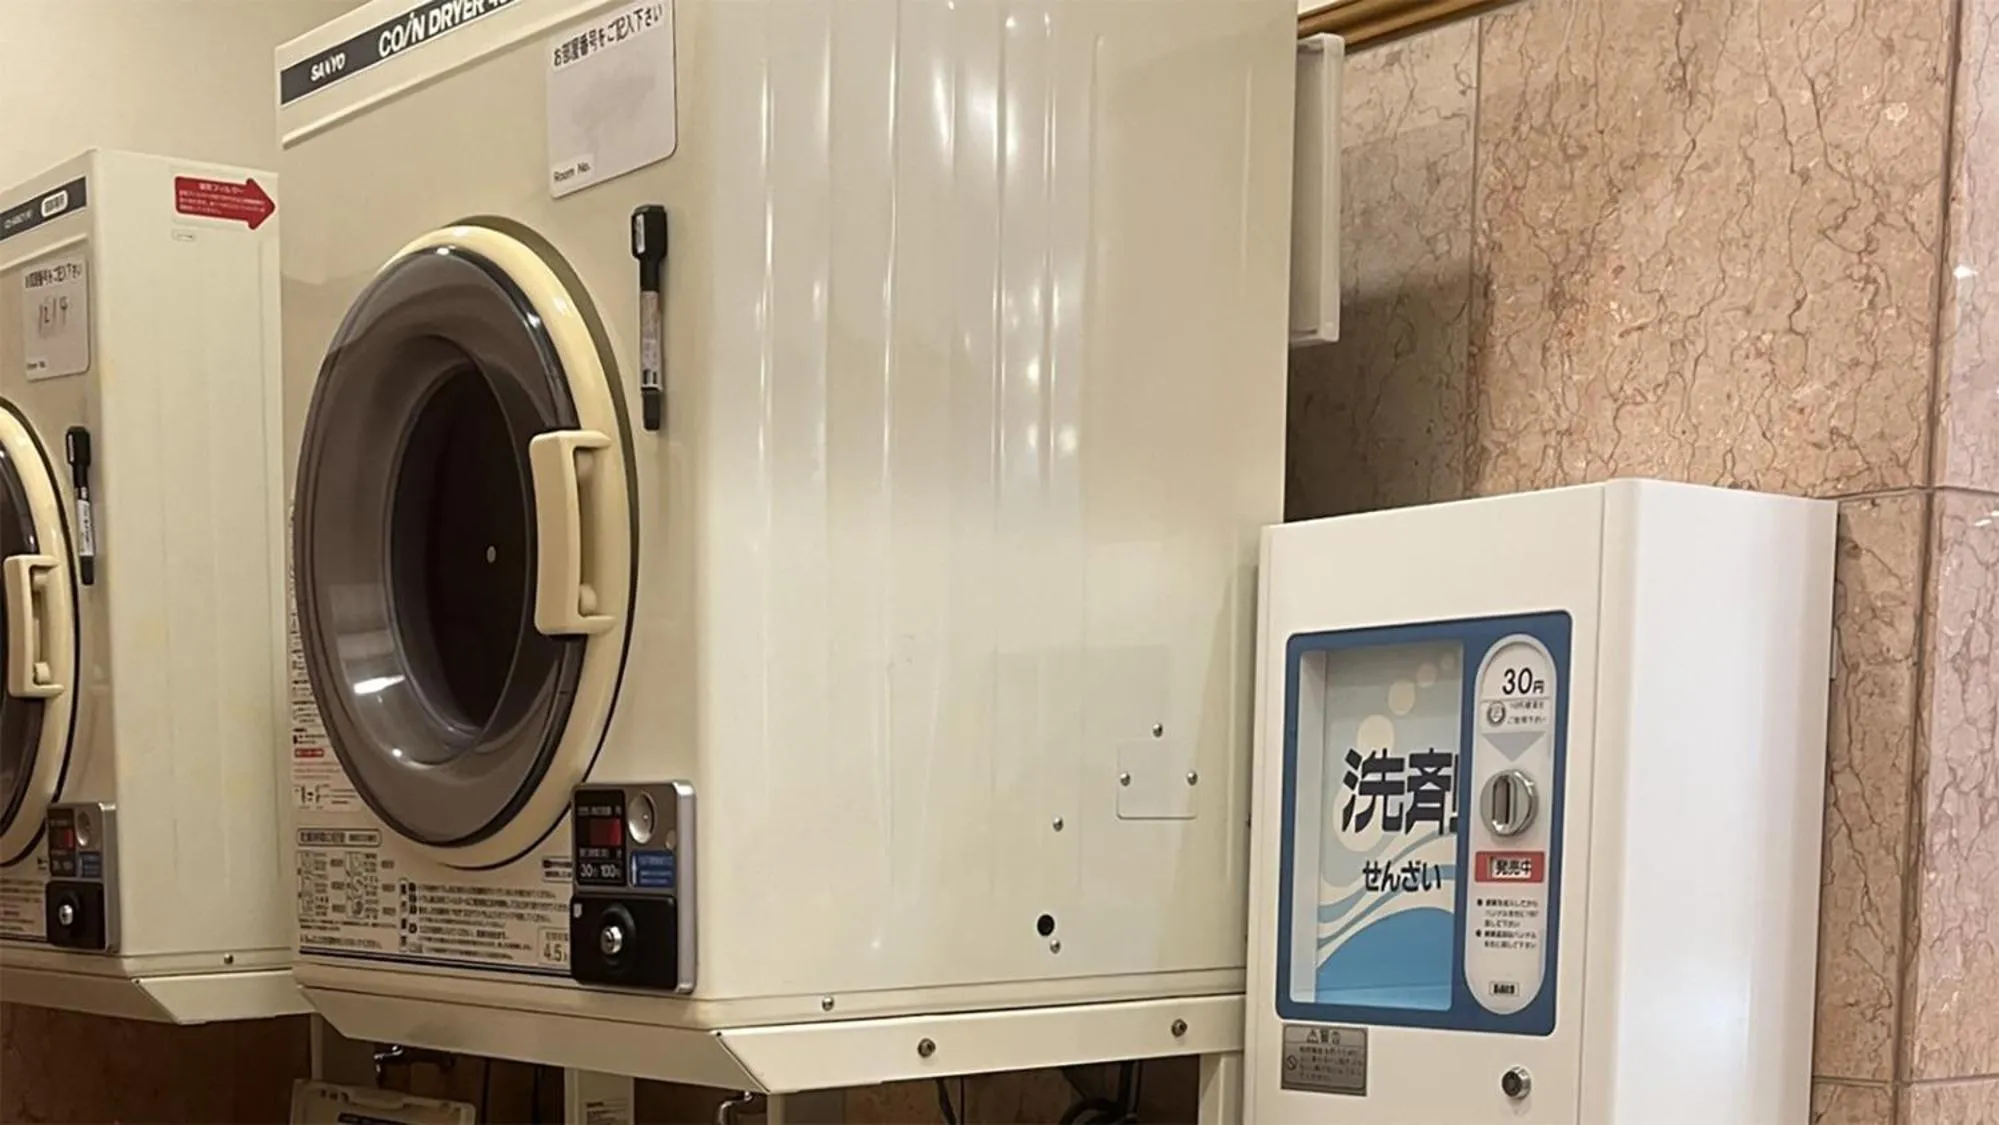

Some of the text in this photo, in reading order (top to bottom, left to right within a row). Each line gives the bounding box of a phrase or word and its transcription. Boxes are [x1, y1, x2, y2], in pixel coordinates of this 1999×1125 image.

[310, 53, 346, 82] SANYO
[428, 0, 485, 36] DRYER
[553, 168, 575, 183] Room
[1502, 667, 1545, 696] 30円
[1342, 747, 1459, 836] 洗剤
[1362, 860, 1442, 893] せんざい
[1495, 858, 1533, 876] 発売中
